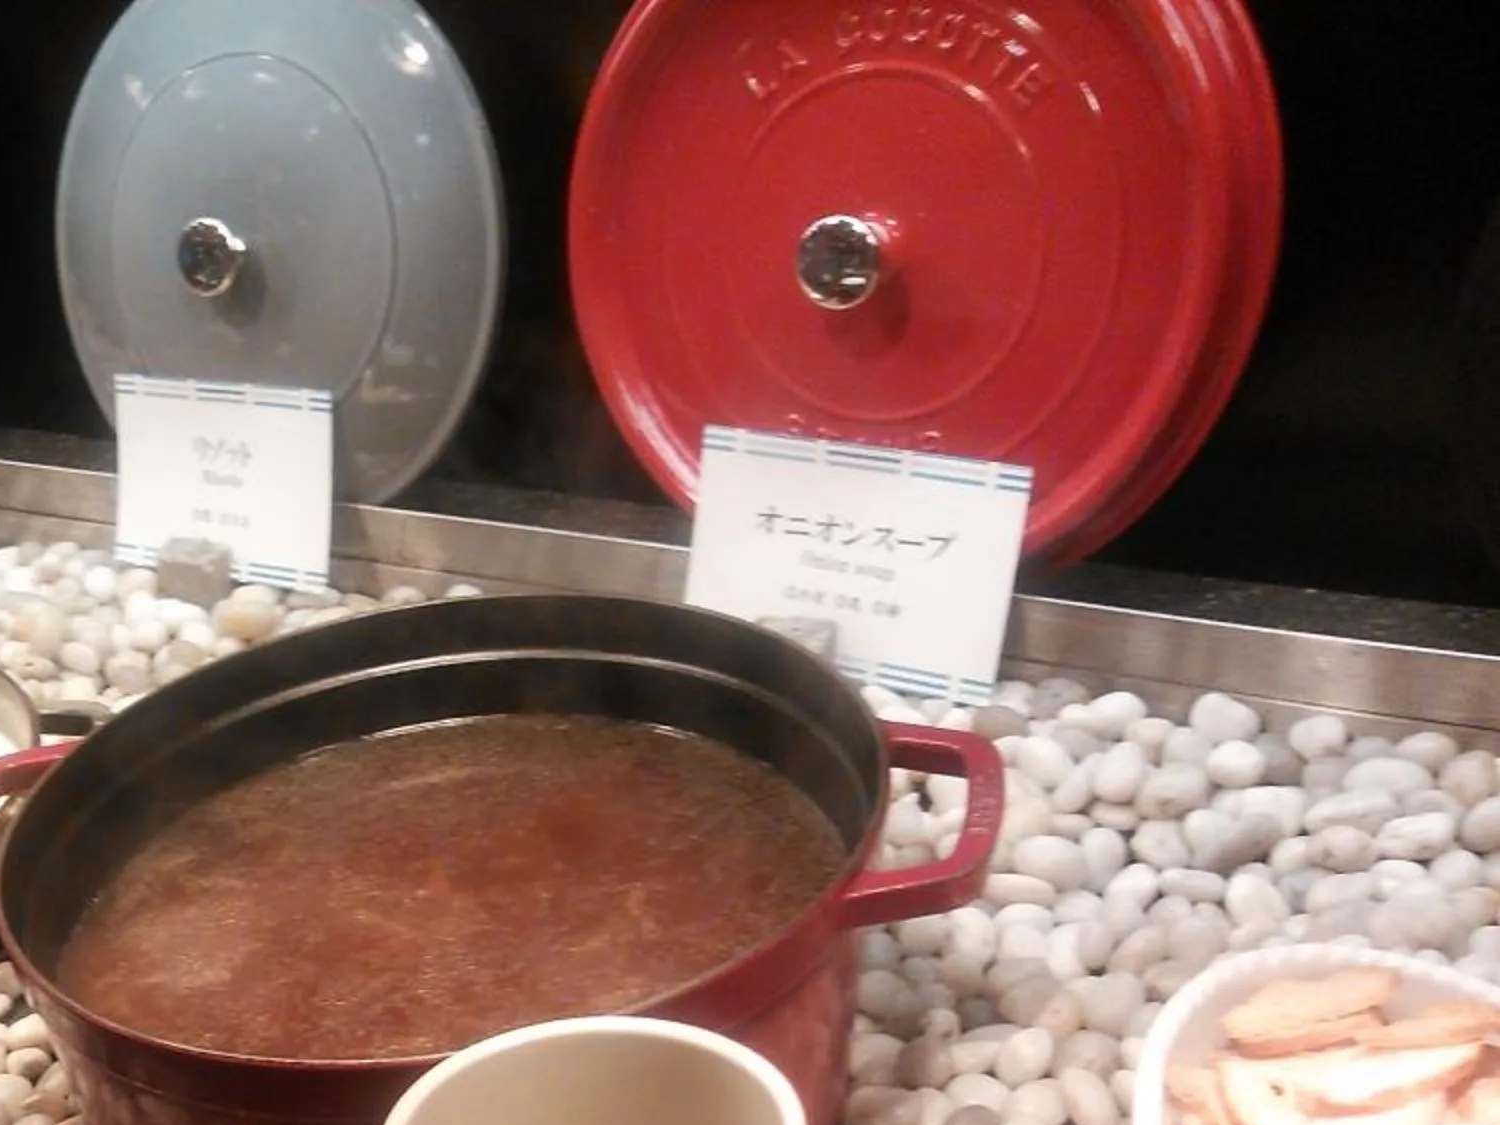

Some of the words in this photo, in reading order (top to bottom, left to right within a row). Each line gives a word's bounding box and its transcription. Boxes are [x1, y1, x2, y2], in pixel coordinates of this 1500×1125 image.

[835, 8, 1049, 106] COCOTTE
[756, 504, 959, 561] オニオンスープ
